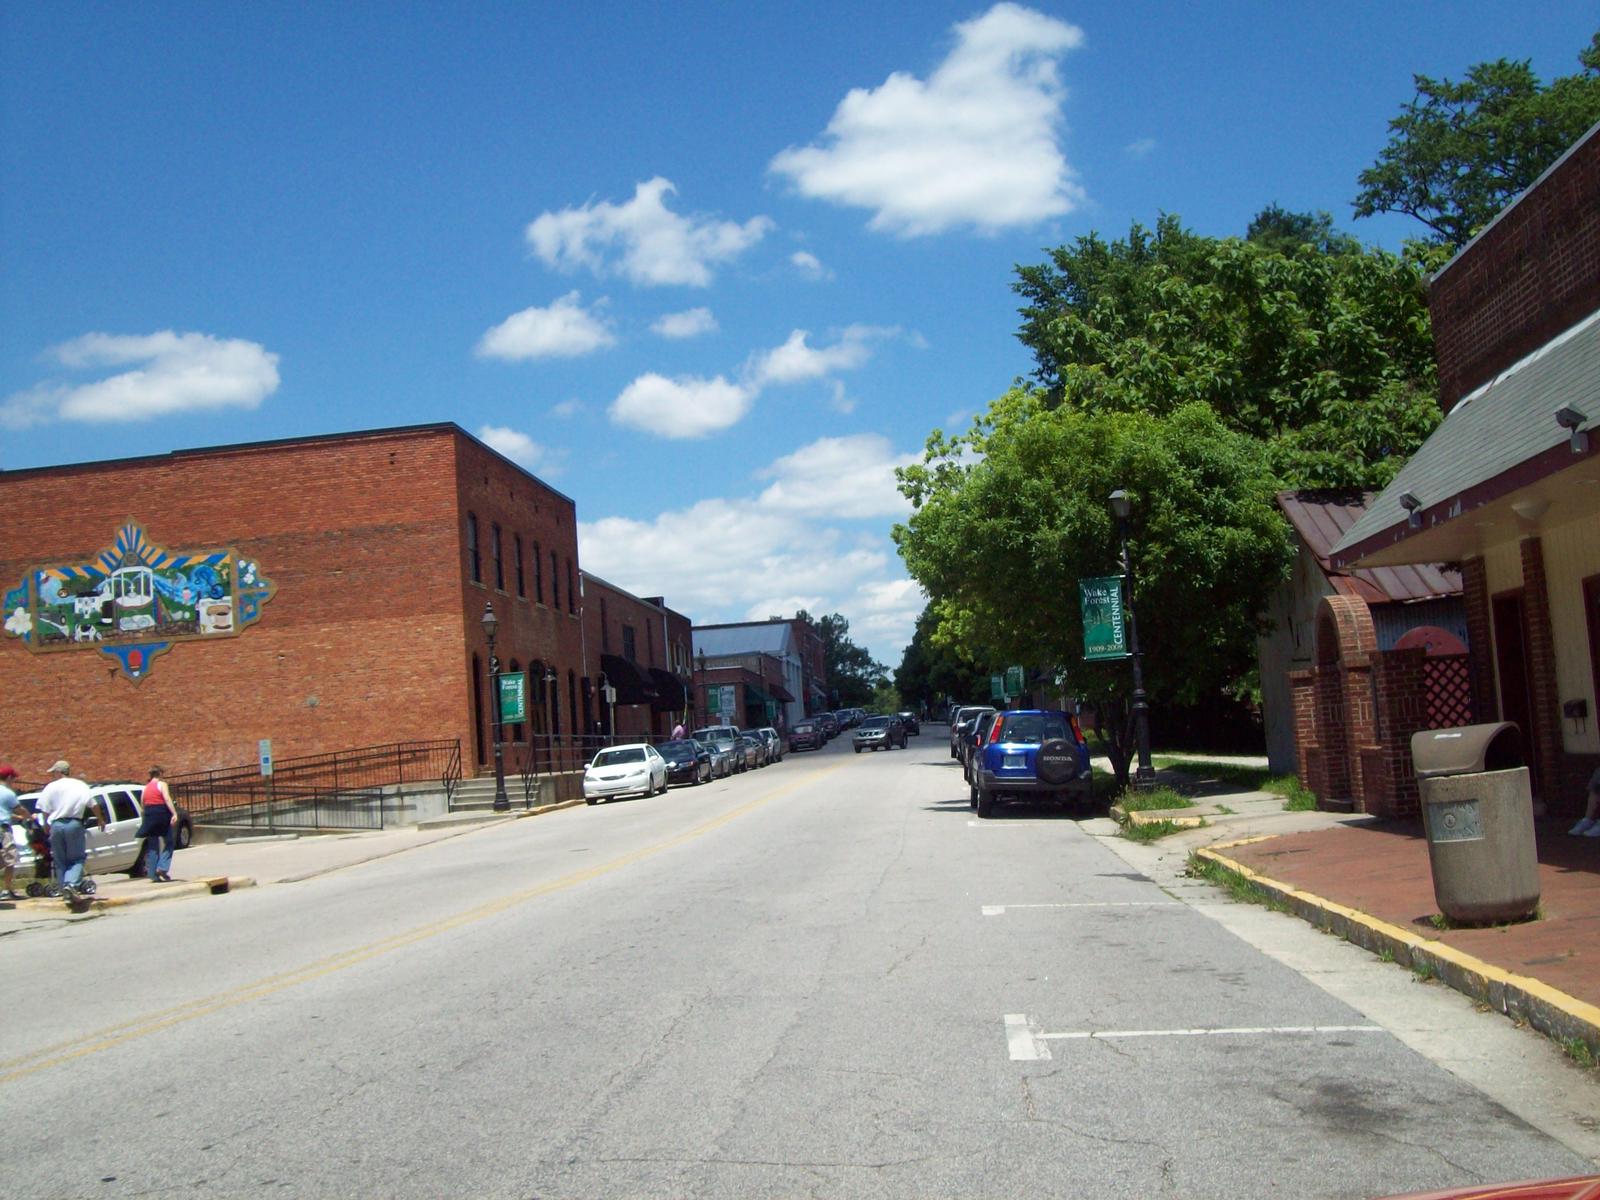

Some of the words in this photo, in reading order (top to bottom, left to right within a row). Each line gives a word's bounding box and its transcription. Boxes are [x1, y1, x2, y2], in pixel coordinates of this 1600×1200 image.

[1084, 588, 1107, 597] Wake
[1084, 596, 1110, 605] Forest
[1110, 586, 1123, 645] CENTENNIAL
